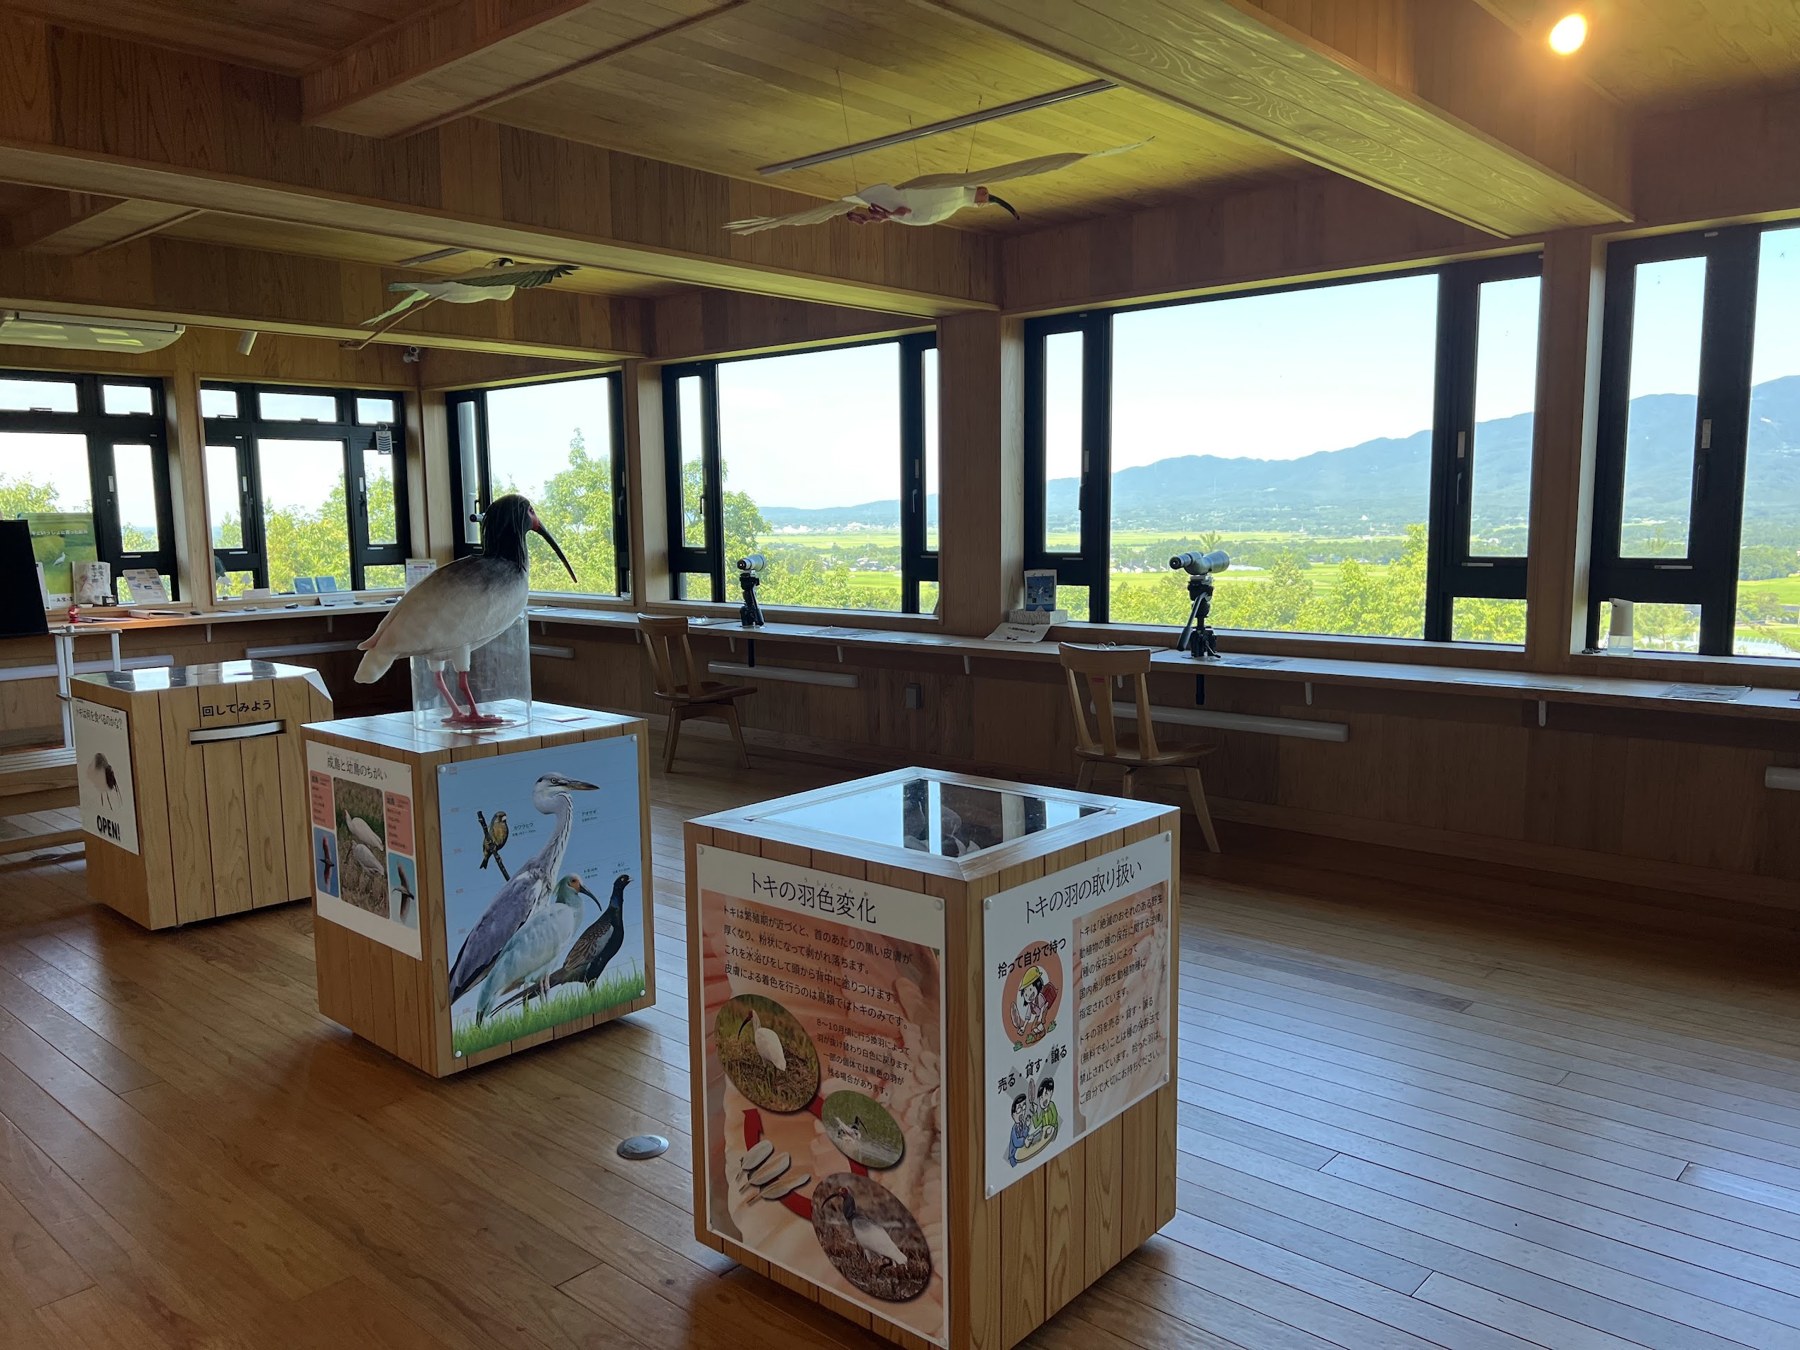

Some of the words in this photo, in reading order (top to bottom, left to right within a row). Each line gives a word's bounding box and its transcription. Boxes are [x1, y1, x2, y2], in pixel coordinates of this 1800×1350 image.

[202, 699, 272, 717] 回してみよう
[96, 815, 121, 842] OPEN!
[752, 872, 877, 924] トキの羽色変化
[1026, 862, 1142, 924] トキの羽の取り扱い
[997, 938, 1067, 979] 拾って自分で持つ
[724, 963, 908, 1030] 皮膚による着色を行うのは鳥類ではトキのみです。
[1079, 987, 1129, 1020] 指定されています。
[997, 1044, 1068, 1094] 売る・貸す・譲る
